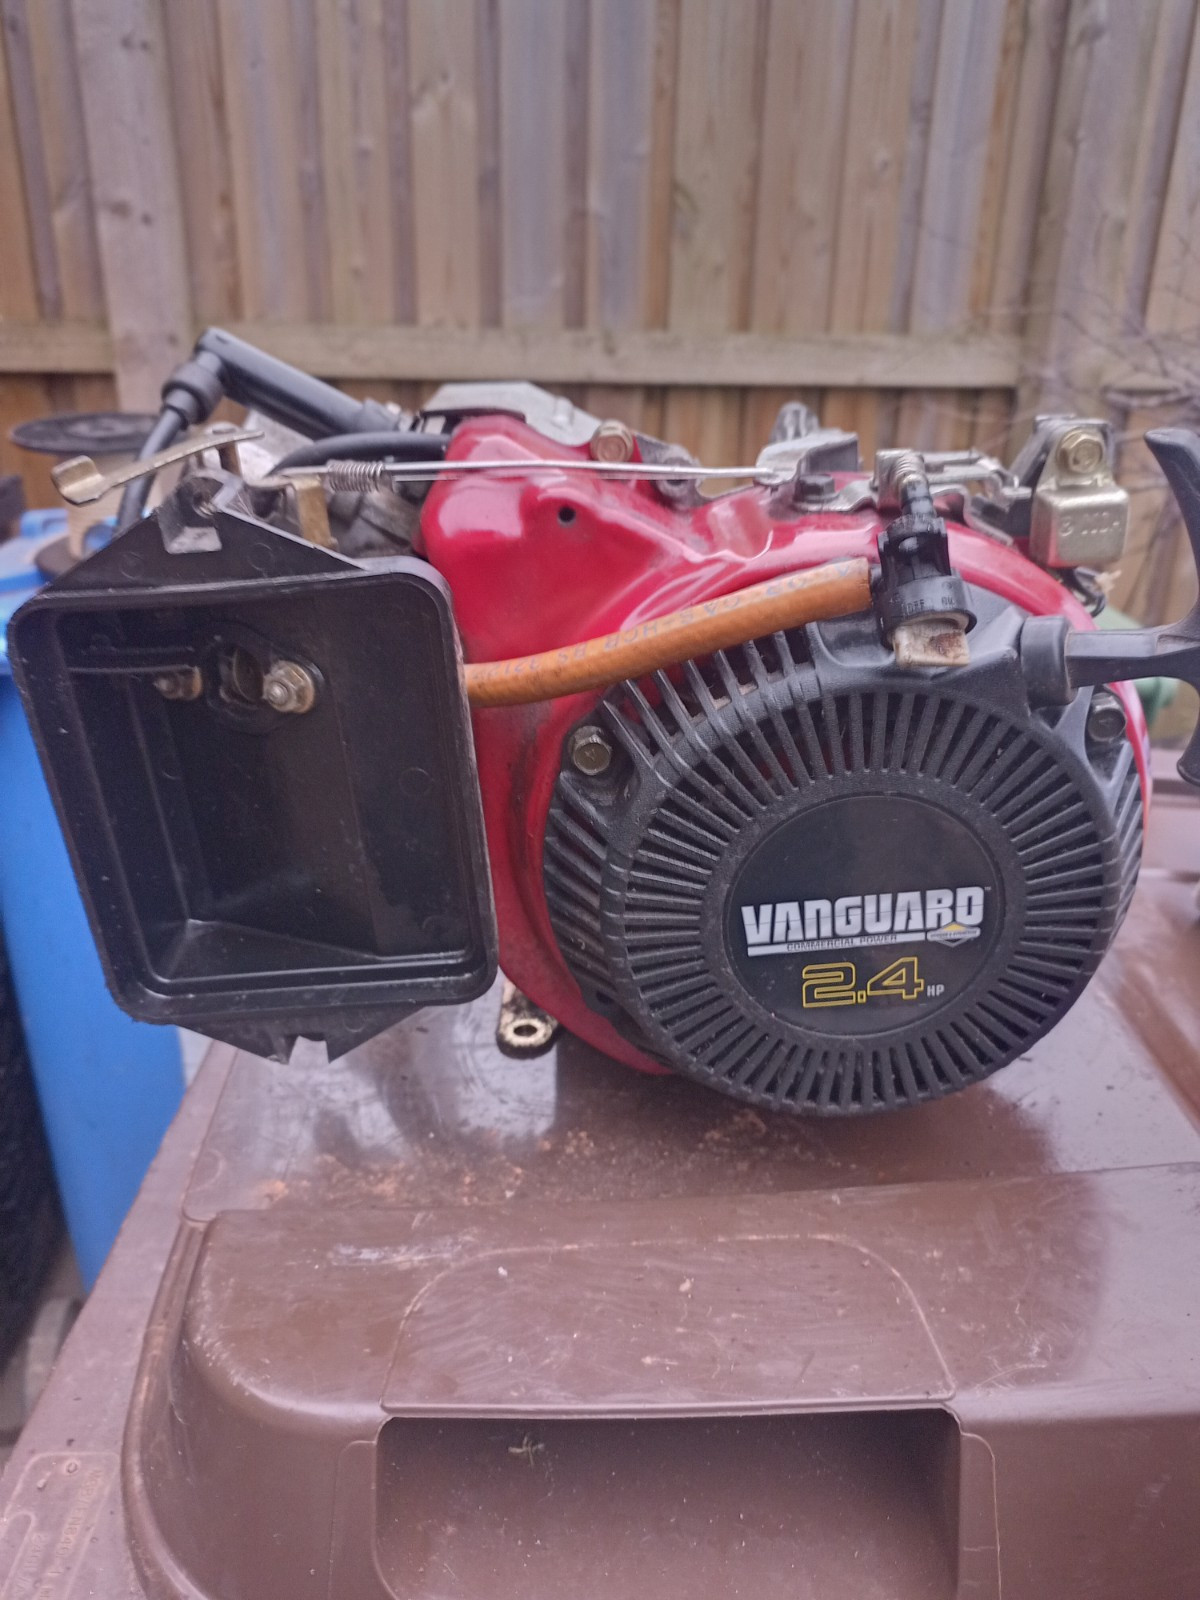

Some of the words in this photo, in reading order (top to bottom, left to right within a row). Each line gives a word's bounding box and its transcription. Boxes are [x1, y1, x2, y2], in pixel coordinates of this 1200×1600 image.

[741, 886, 985, 945] VANGUARD
[787, 936, 855, 952] COMMERCIAL
[859, 933, 897, 946] POWER
[802, 956, 925, 1008] 2.4
[926, 984, 945, 997] HP
